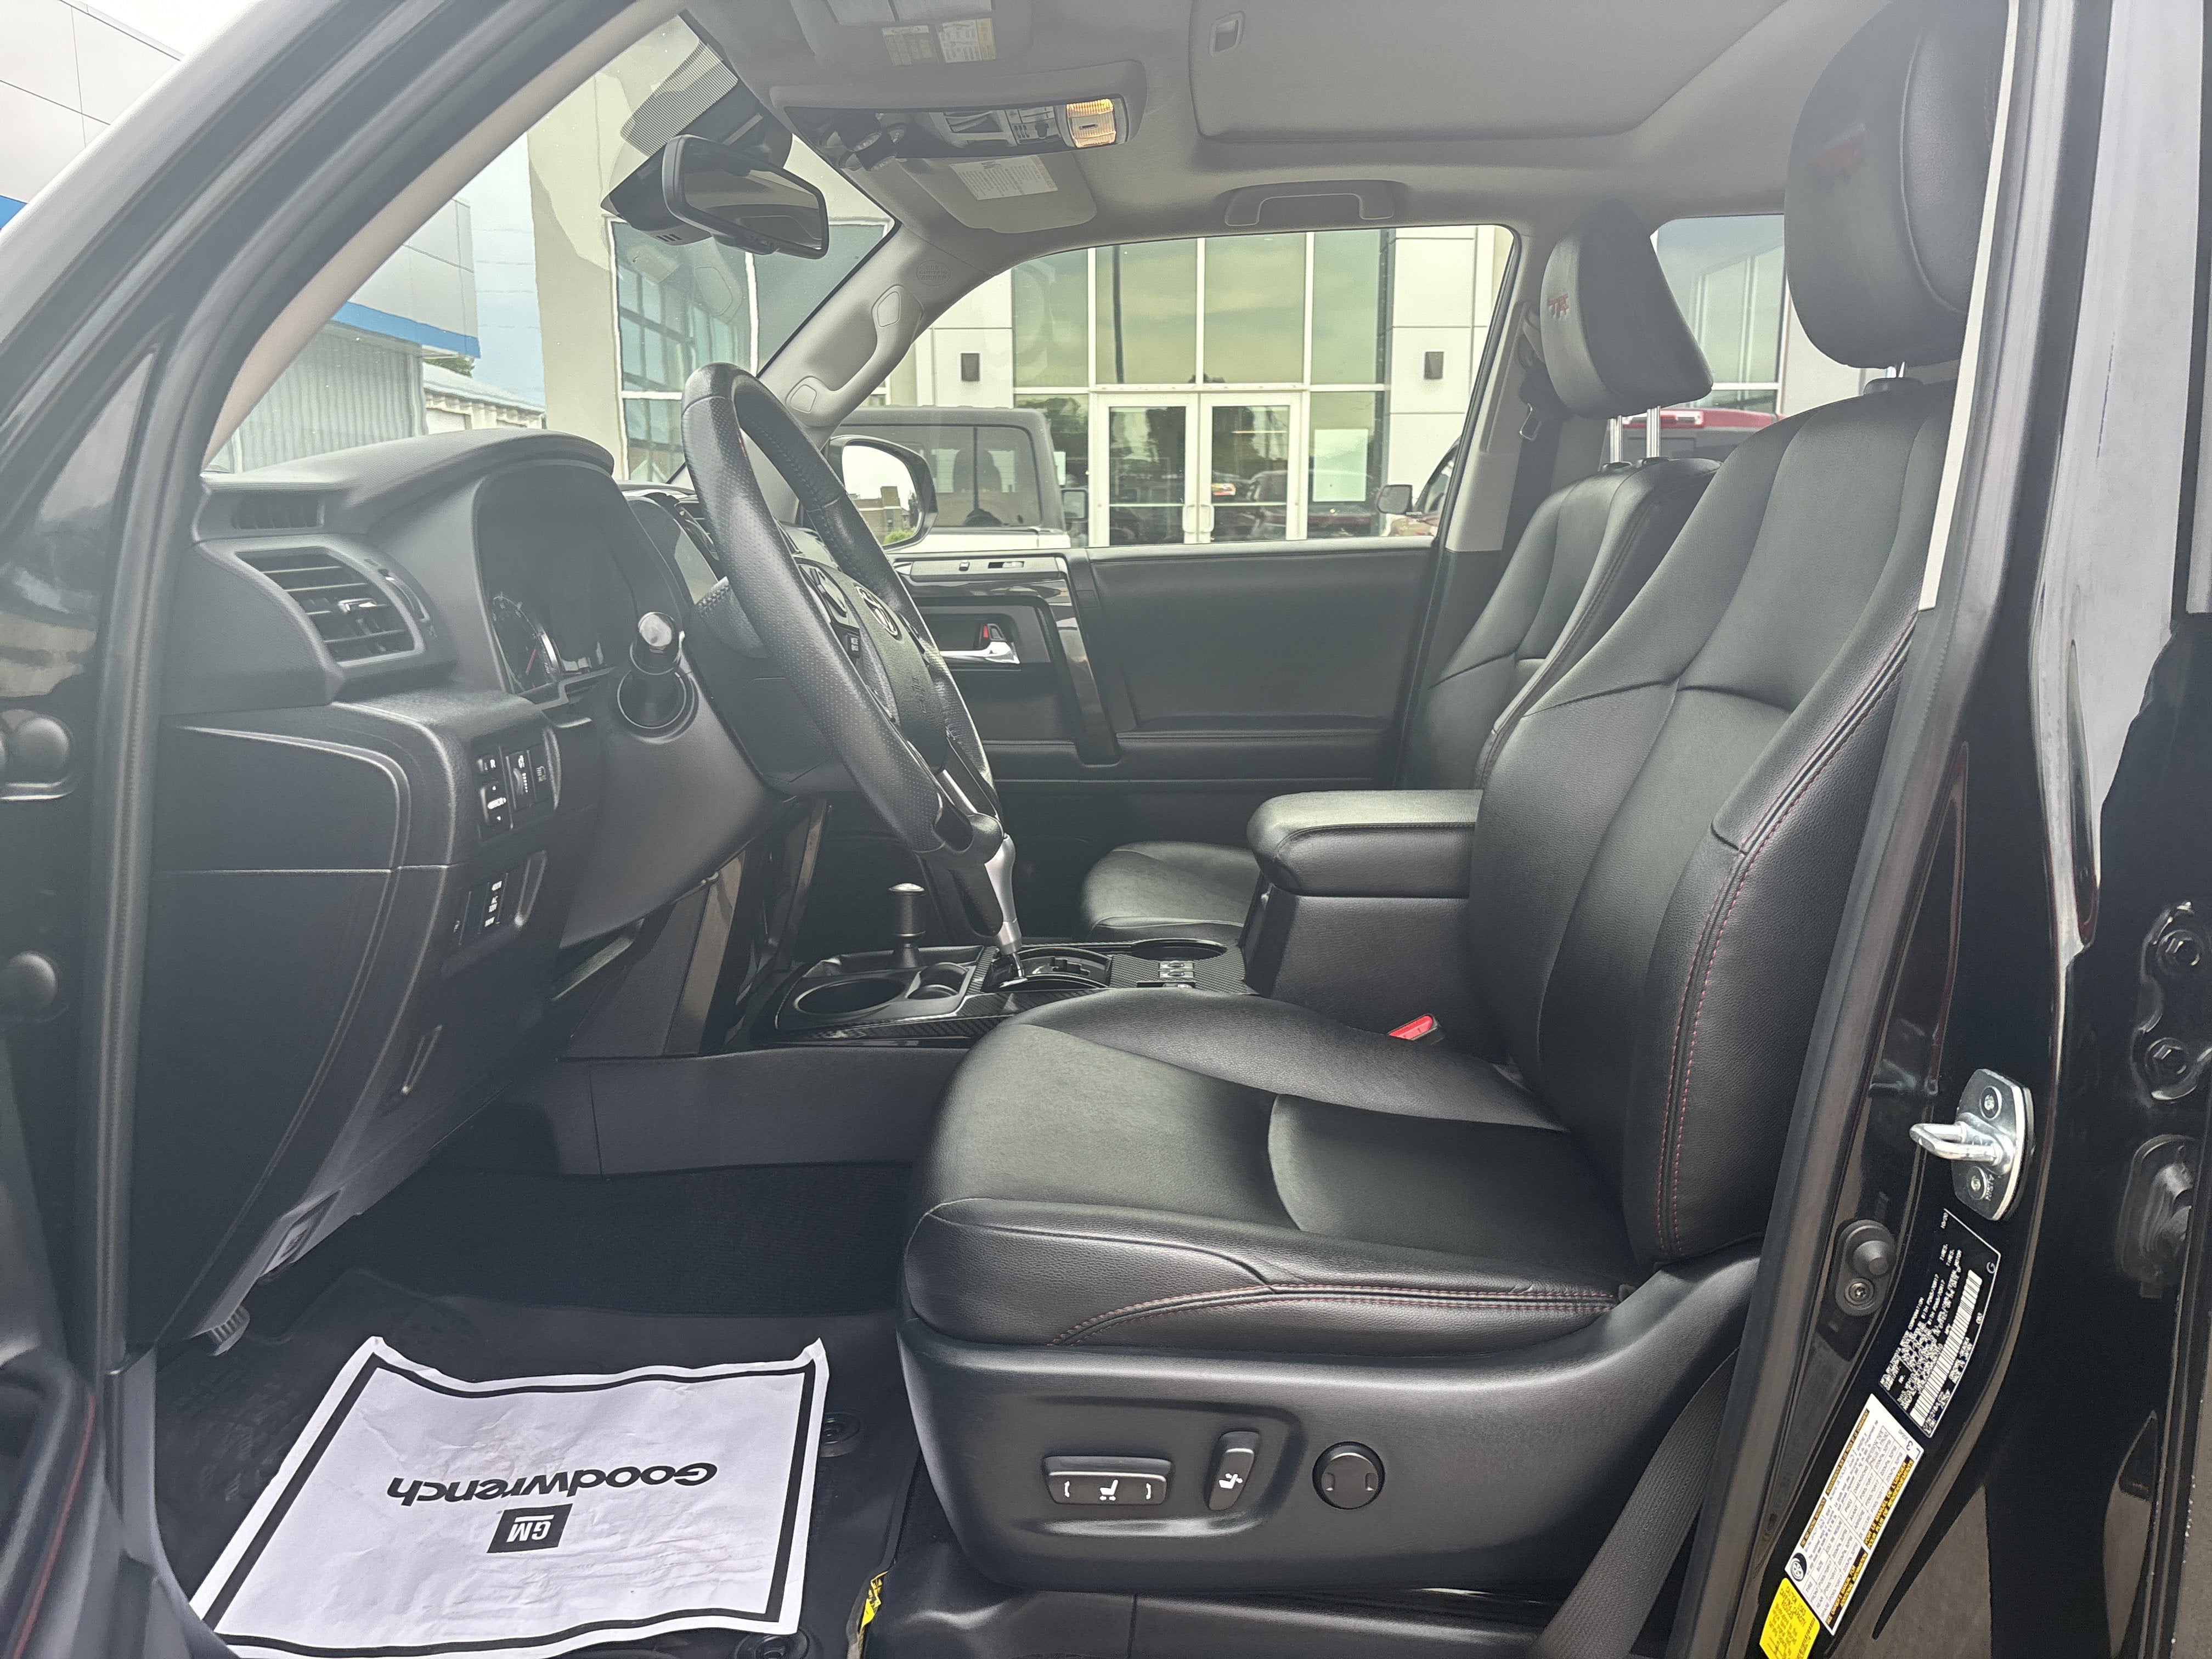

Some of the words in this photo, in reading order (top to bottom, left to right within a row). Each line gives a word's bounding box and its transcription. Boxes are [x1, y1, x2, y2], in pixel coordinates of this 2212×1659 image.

[490, 759, 496, 769] R
[387, 1463, 718, 1506] Goodwrench
[506, 1521, 551, 1543] GM
